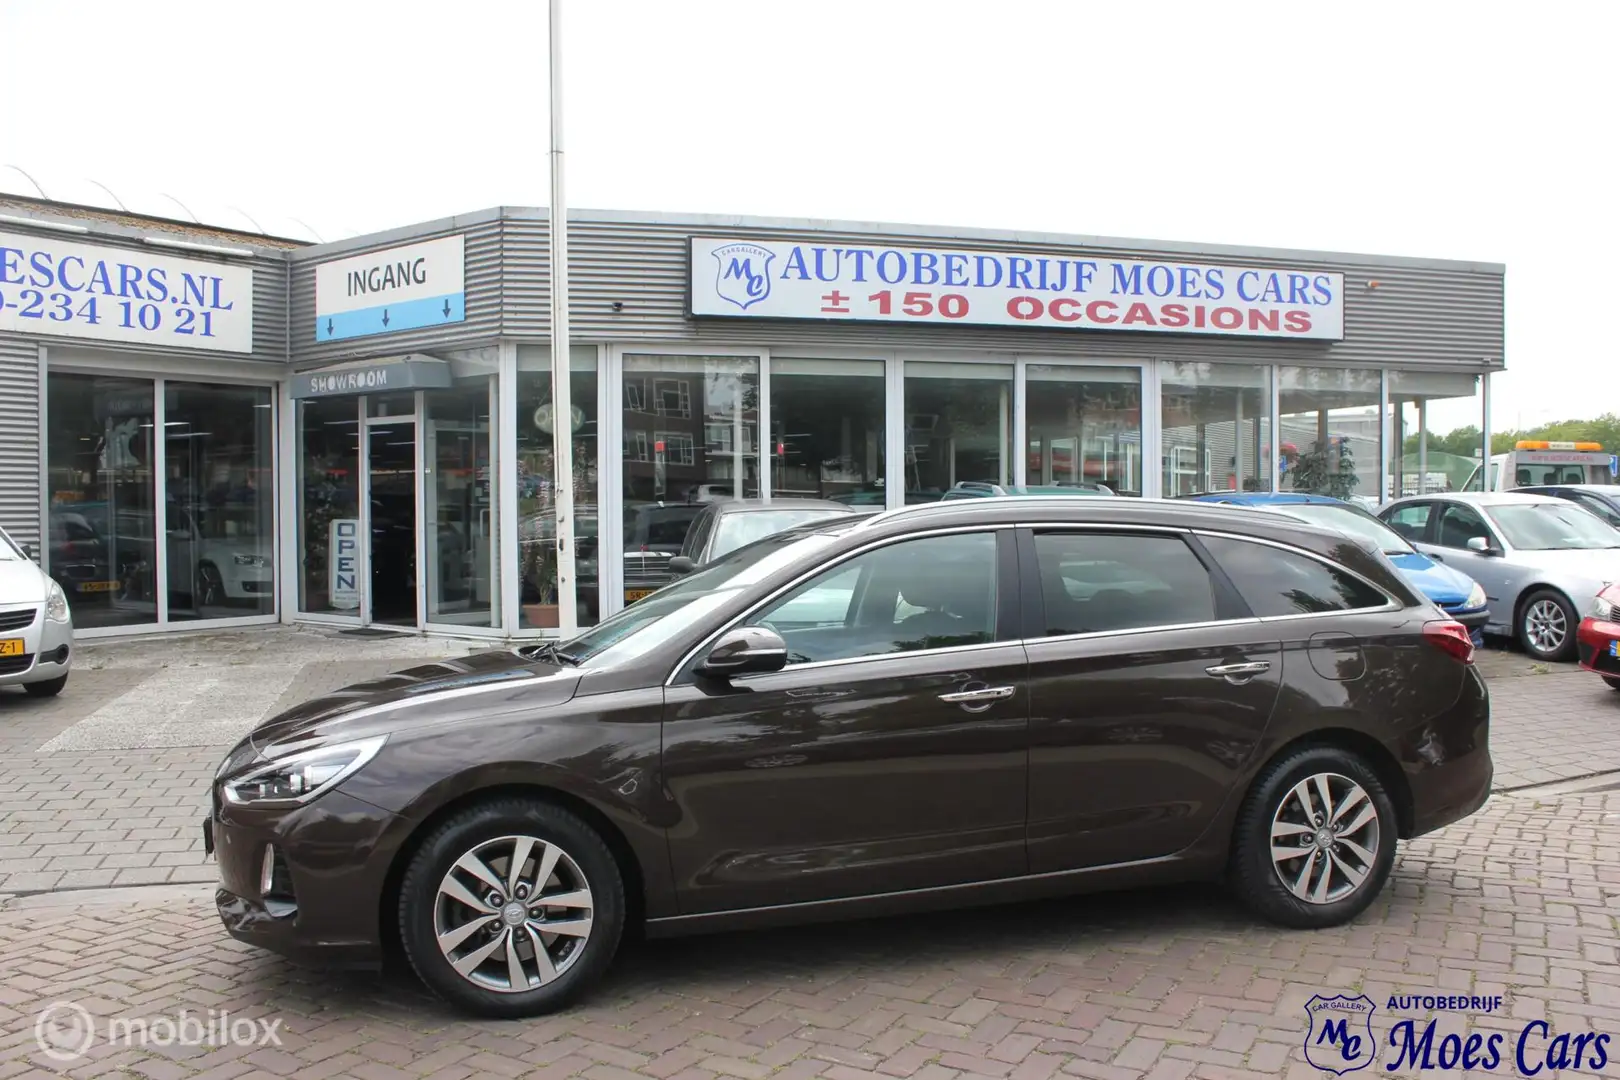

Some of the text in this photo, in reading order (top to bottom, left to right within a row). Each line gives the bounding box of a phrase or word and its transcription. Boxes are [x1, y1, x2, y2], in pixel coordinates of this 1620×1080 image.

[347, 257, 426, 297] INGANG
[780, 246, 1332, 306] AUTOBEDRIJF MOES CARS
[0, 289, 216, 337] -234 10 21
[868, 290, 970, 318] 150
[1006, 296, 1312, 333] OCCASIONS
[311, 370, 387, 392] SHOWROOM
[337, 523, 356, 590] OPEN
